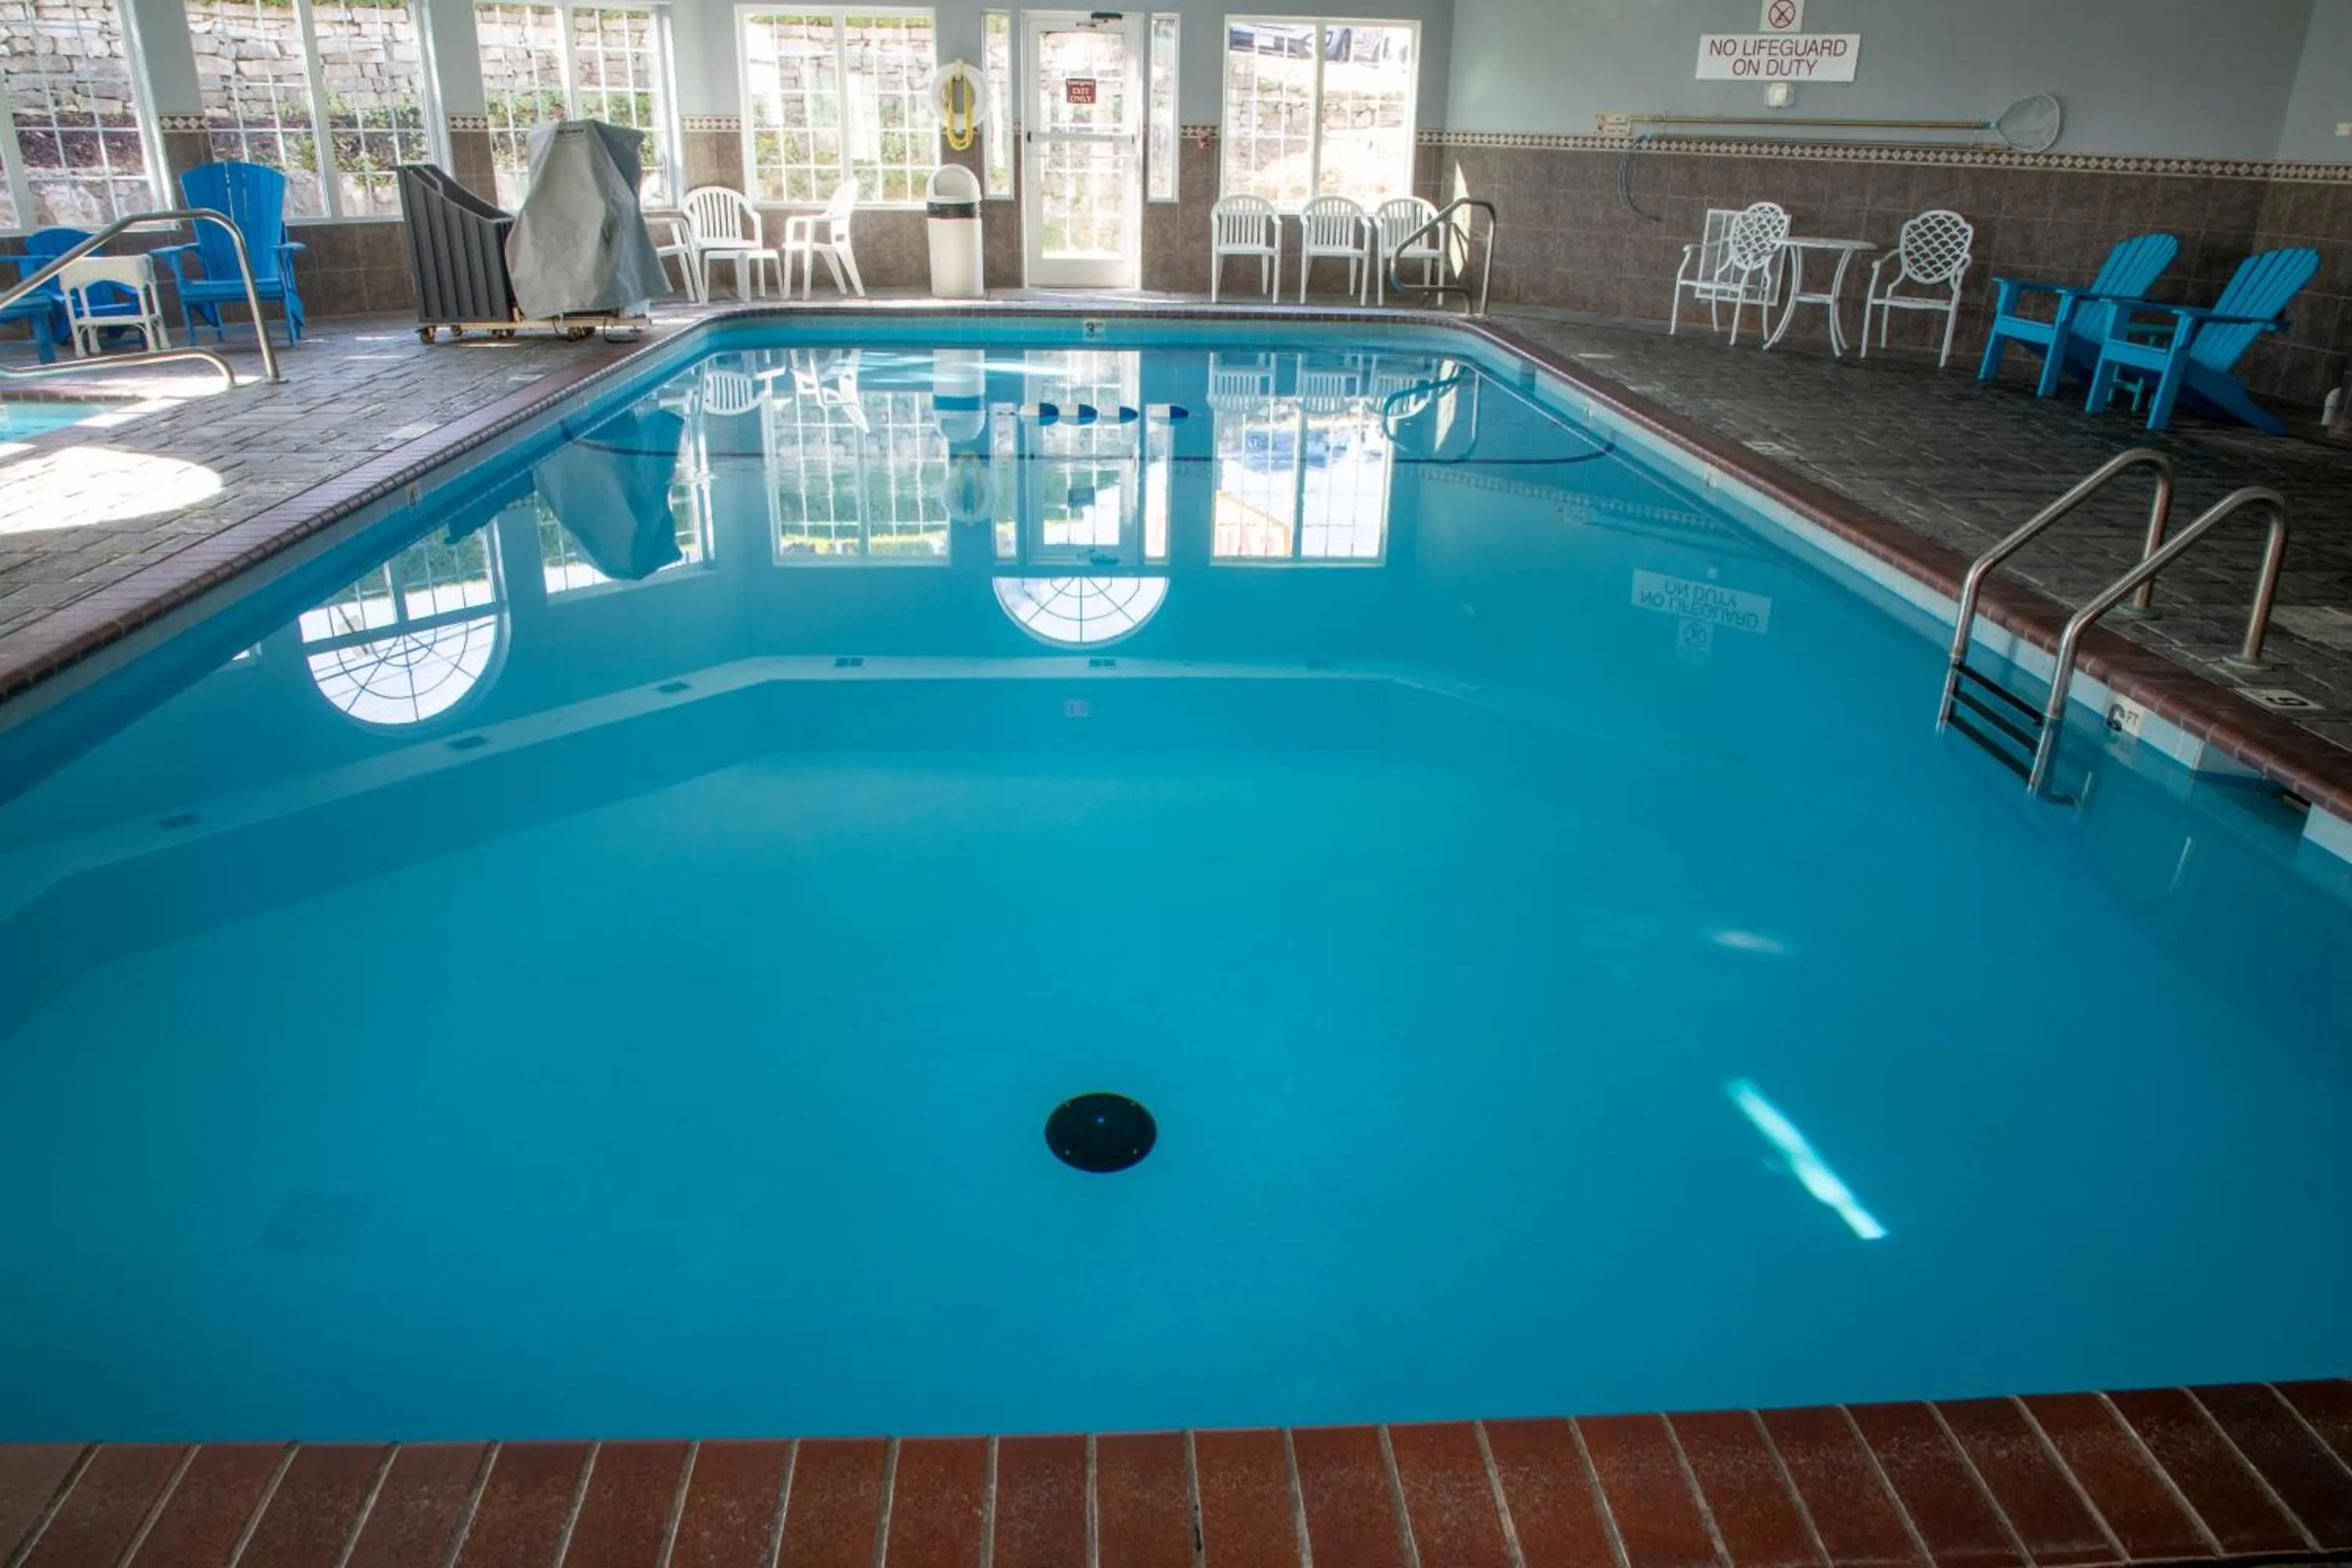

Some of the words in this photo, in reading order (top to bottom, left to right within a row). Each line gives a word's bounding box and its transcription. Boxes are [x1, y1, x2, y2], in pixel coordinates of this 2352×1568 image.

[1710, 38, 1737, 56] NO
[1743, 38, 1847, 56] LIFEGUARD
[1732, 59, 1760, 76] ON
[1766, 59, 1817, 76] DUTY
[2125, 710, 2140, 728] FT
